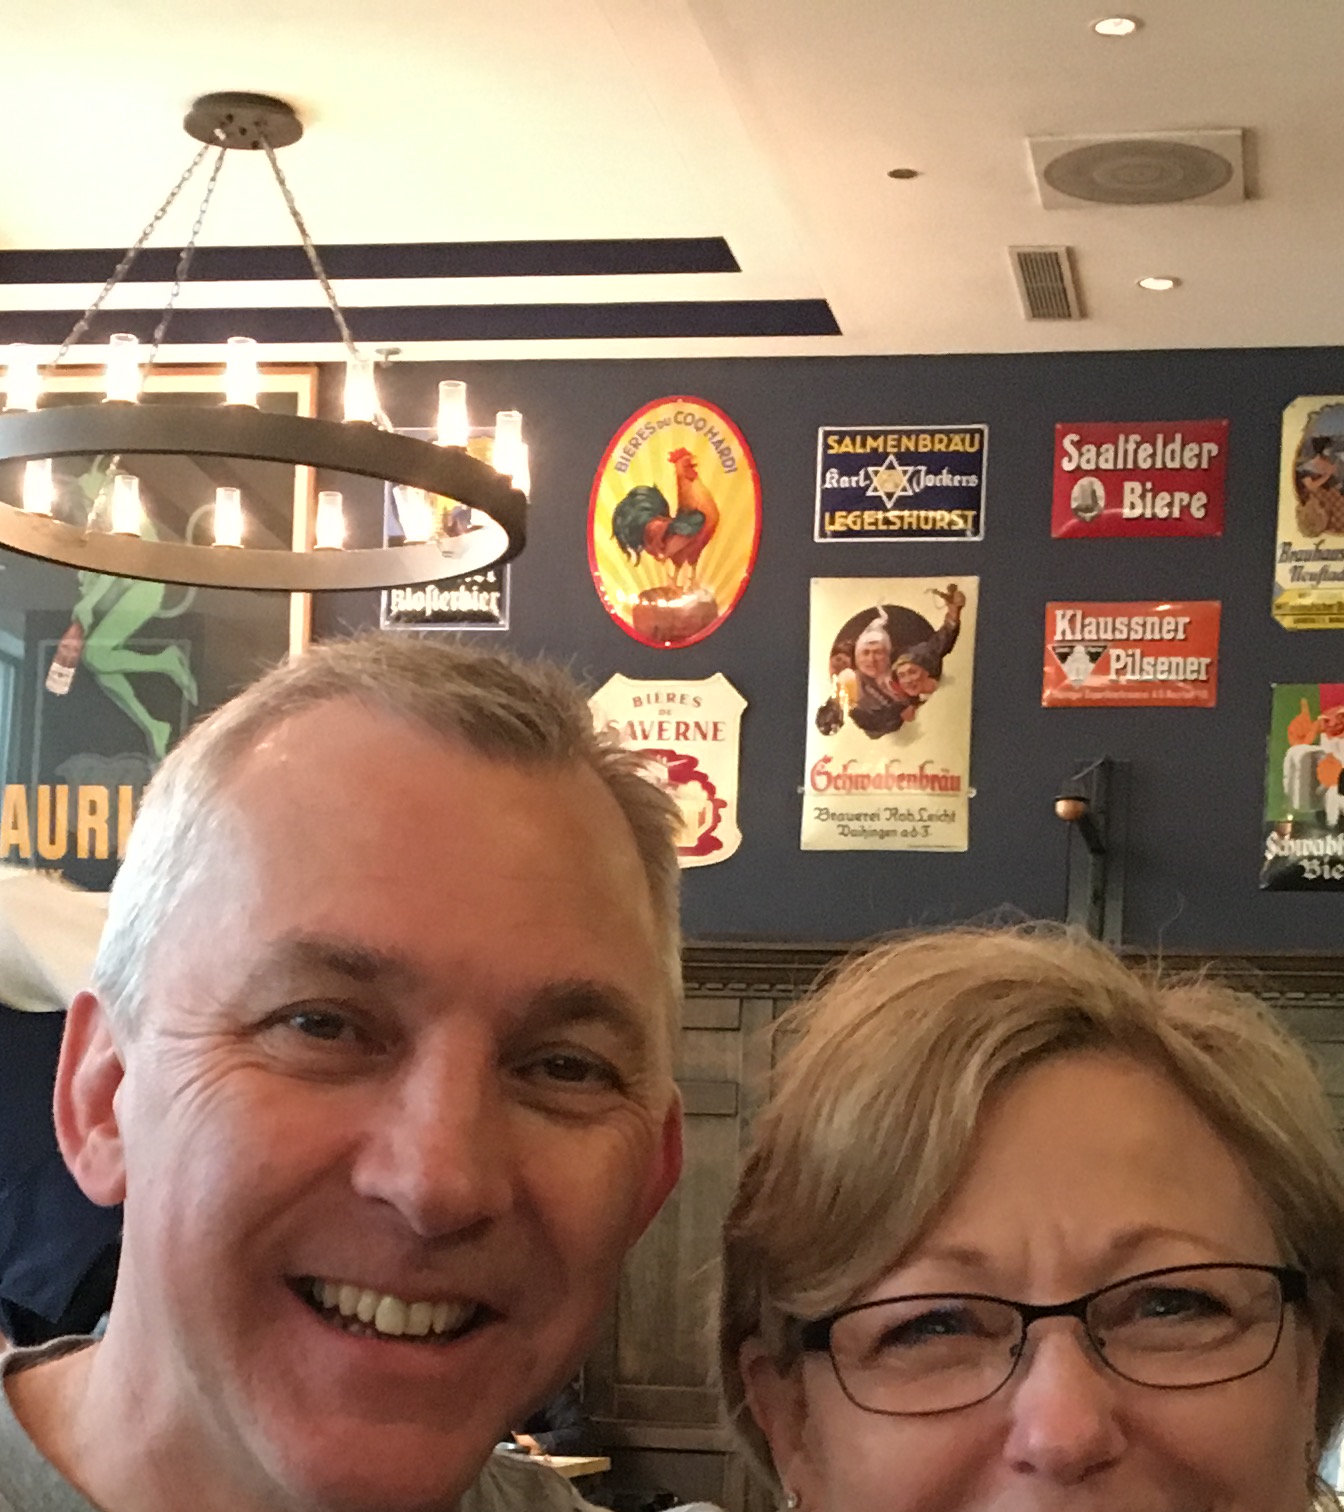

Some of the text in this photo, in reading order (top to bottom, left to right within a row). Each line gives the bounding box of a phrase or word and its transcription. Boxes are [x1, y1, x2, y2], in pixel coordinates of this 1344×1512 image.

[656, 417, 672, 430] DU
[673, 410, 707, 432] COQ
[704, 425, 738, 474] HARDI
[827, 432, 981, 454] SALMENBRÄU
[1061, 432, 1219, 472] Saalfelder
[822, 465, 979, 494] Karl Jockers
[1122, 481, 1208, 519] Biere
[824, 510, 977, 531] LEGELSHURST
[1054, 609, 1190, 641] Klaussner
[1109, 648, 1213, 681] Pilsener
[810, 754, 961, 792] Schwabenbräu
[814, 807, 881, 823] Brauerei
